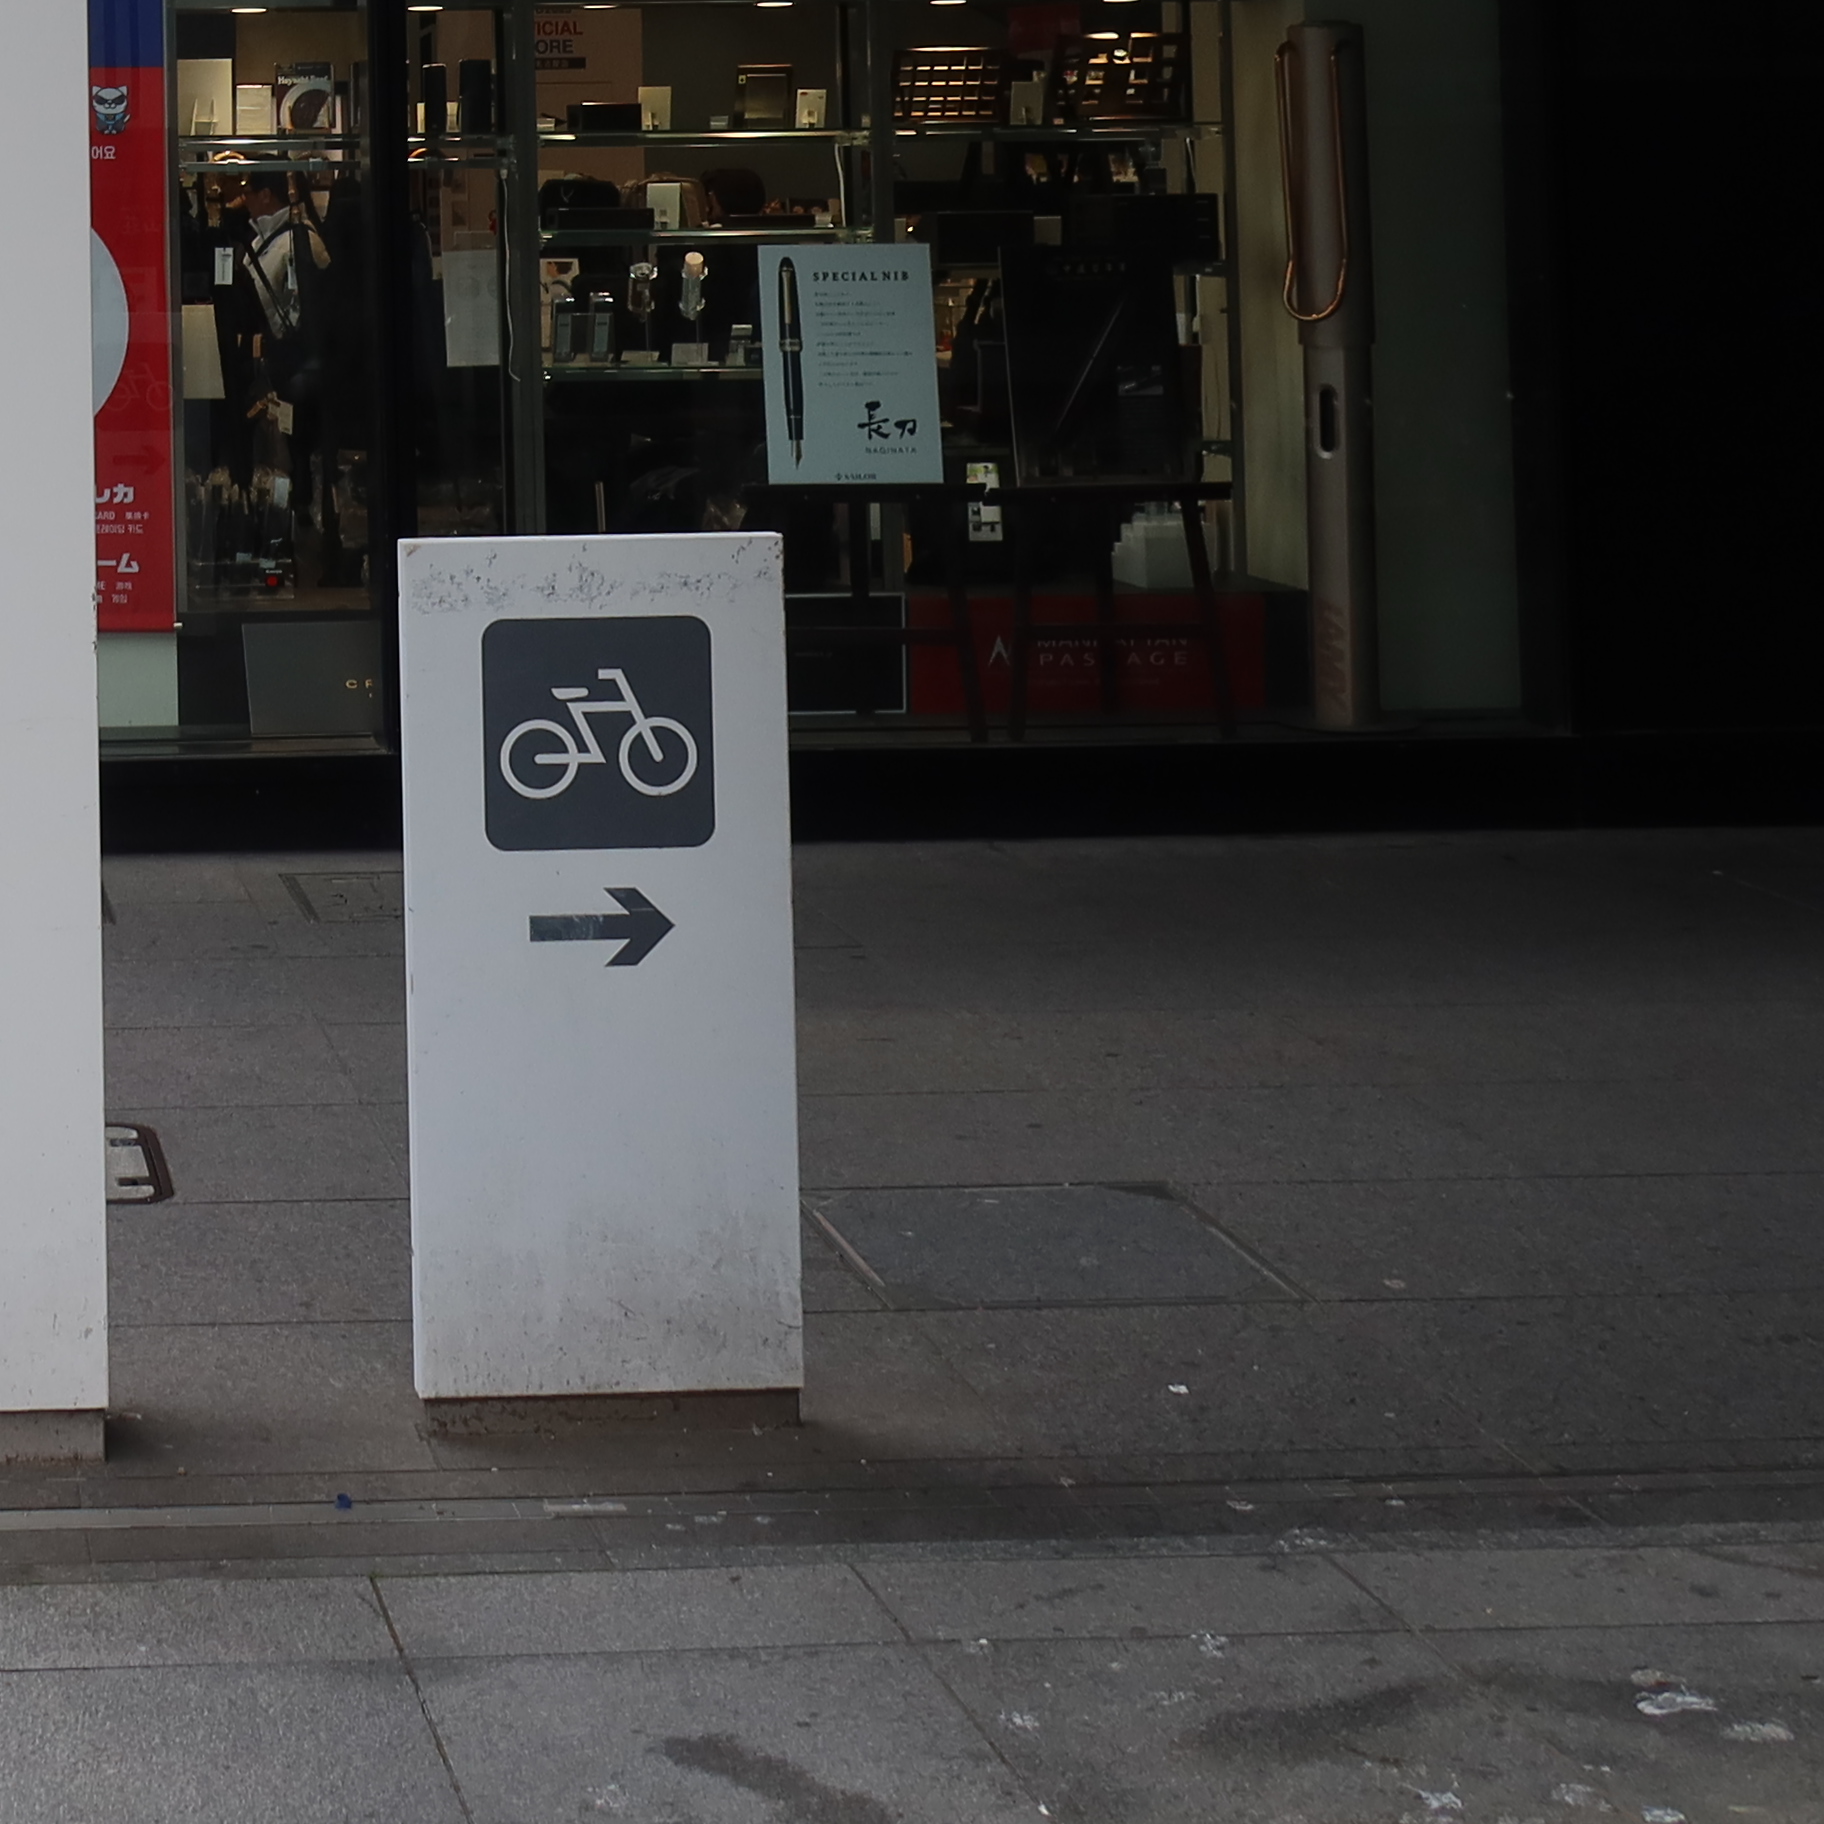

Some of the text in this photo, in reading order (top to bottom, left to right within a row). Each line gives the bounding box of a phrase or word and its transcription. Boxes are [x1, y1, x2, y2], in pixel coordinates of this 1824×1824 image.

[535, 20, 583, 35] ICIAL
[536, 39, 573, 54] ORE
[91, 145, 116, 160] 어요
[813, 270, 909, 281] SPECIAL NIB
[857, 400, 917, 440] 長刀
[95, 483, 134, 503] レカ
[96, 511, 116, 520] ARD
[97, 552, 139, 573] ーム
[1039, 652, 1187, 666] PASAGE
